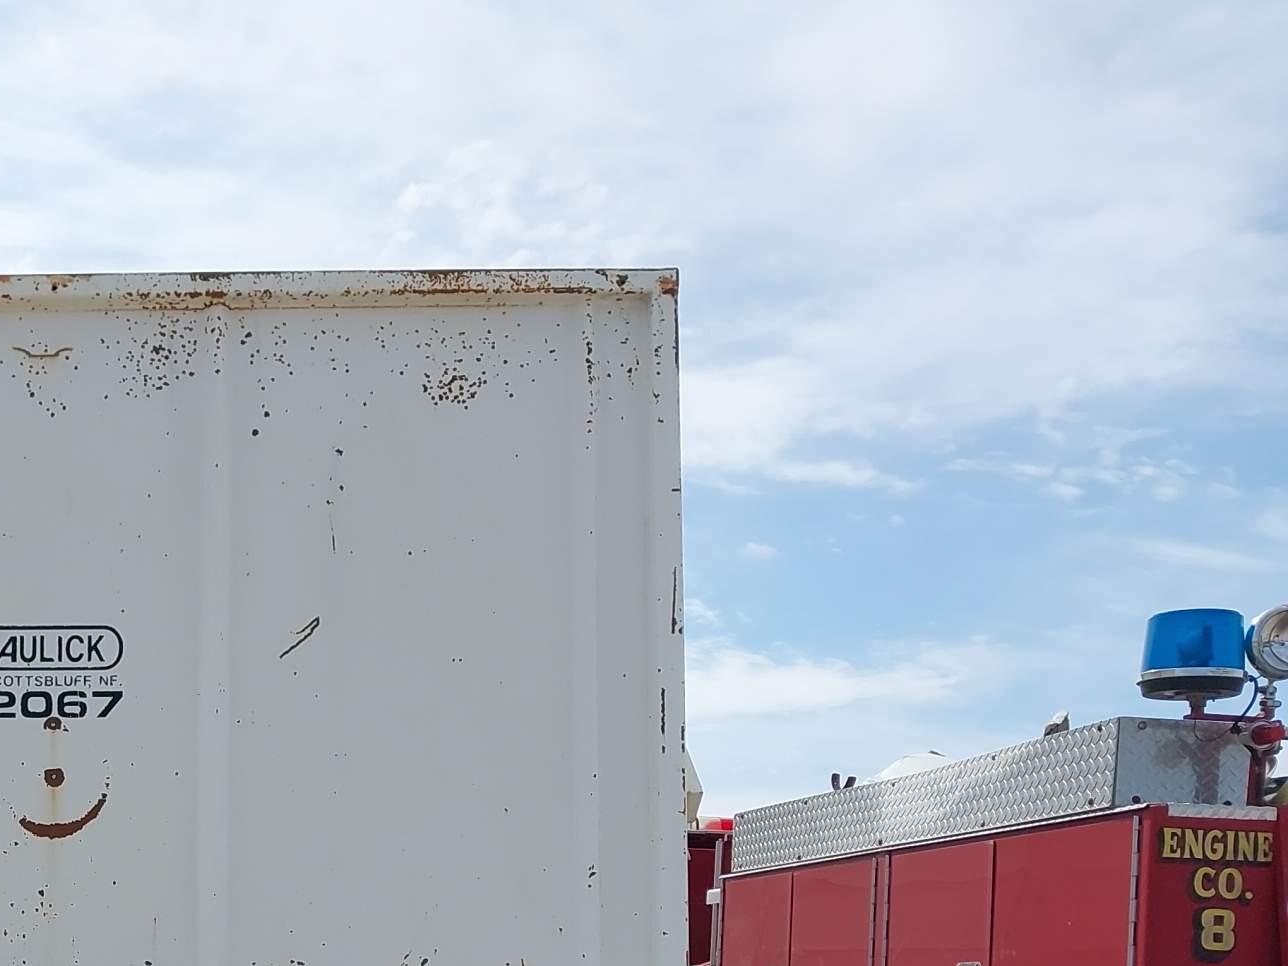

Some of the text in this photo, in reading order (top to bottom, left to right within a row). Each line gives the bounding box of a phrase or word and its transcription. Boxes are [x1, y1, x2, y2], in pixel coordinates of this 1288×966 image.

[1162, 827, 1273, 862] ENGINE
[1194, 867, 1253, 900] CO.
[1201, 909, 1235, 951] 8
